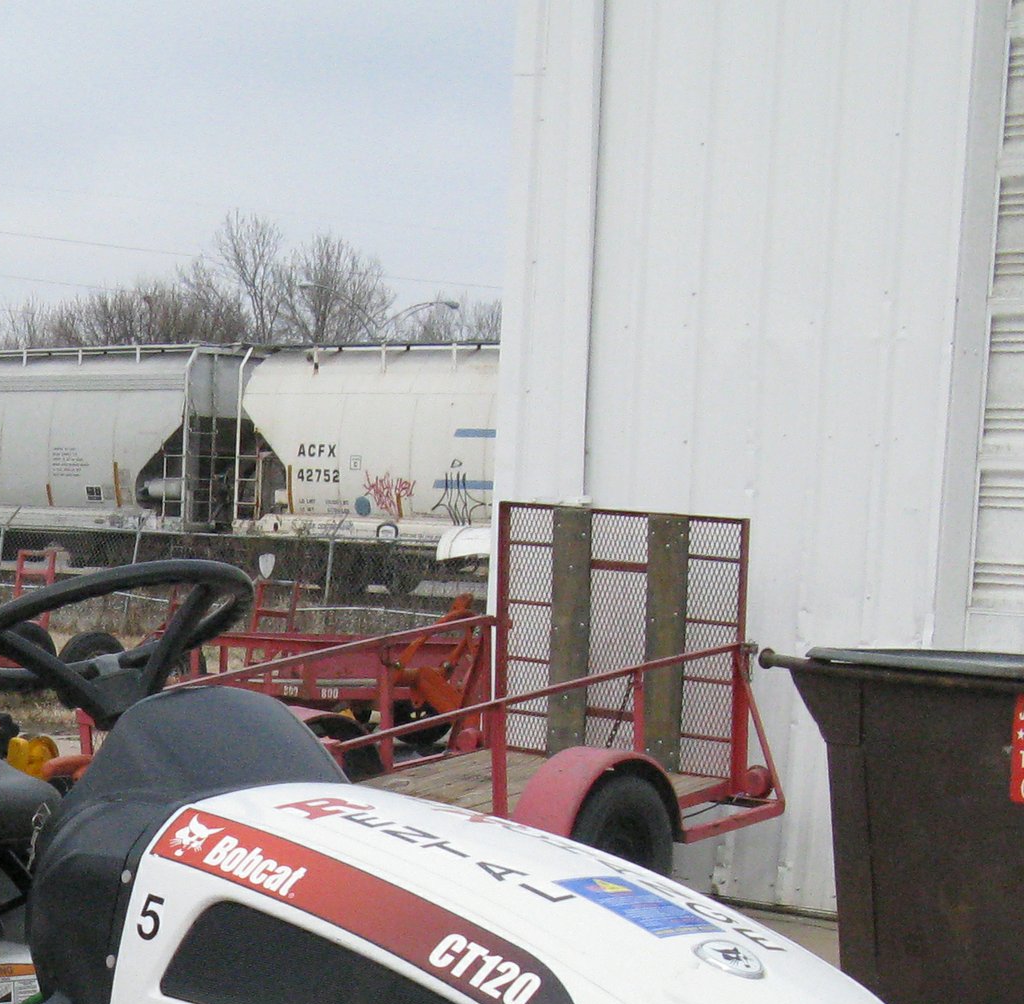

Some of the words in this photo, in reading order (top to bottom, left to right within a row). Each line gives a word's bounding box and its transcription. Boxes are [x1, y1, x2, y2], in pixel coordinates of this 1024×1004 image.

[297, 443, 337, 458] ACFX
[297, 469, 340, 483] 42752
[321, 688, 339, 699] 800
[275, 797, 577, 903] RENTAL
[203, 835, 307, 897] Bobcat
[137, 893, 165, 941] 5
